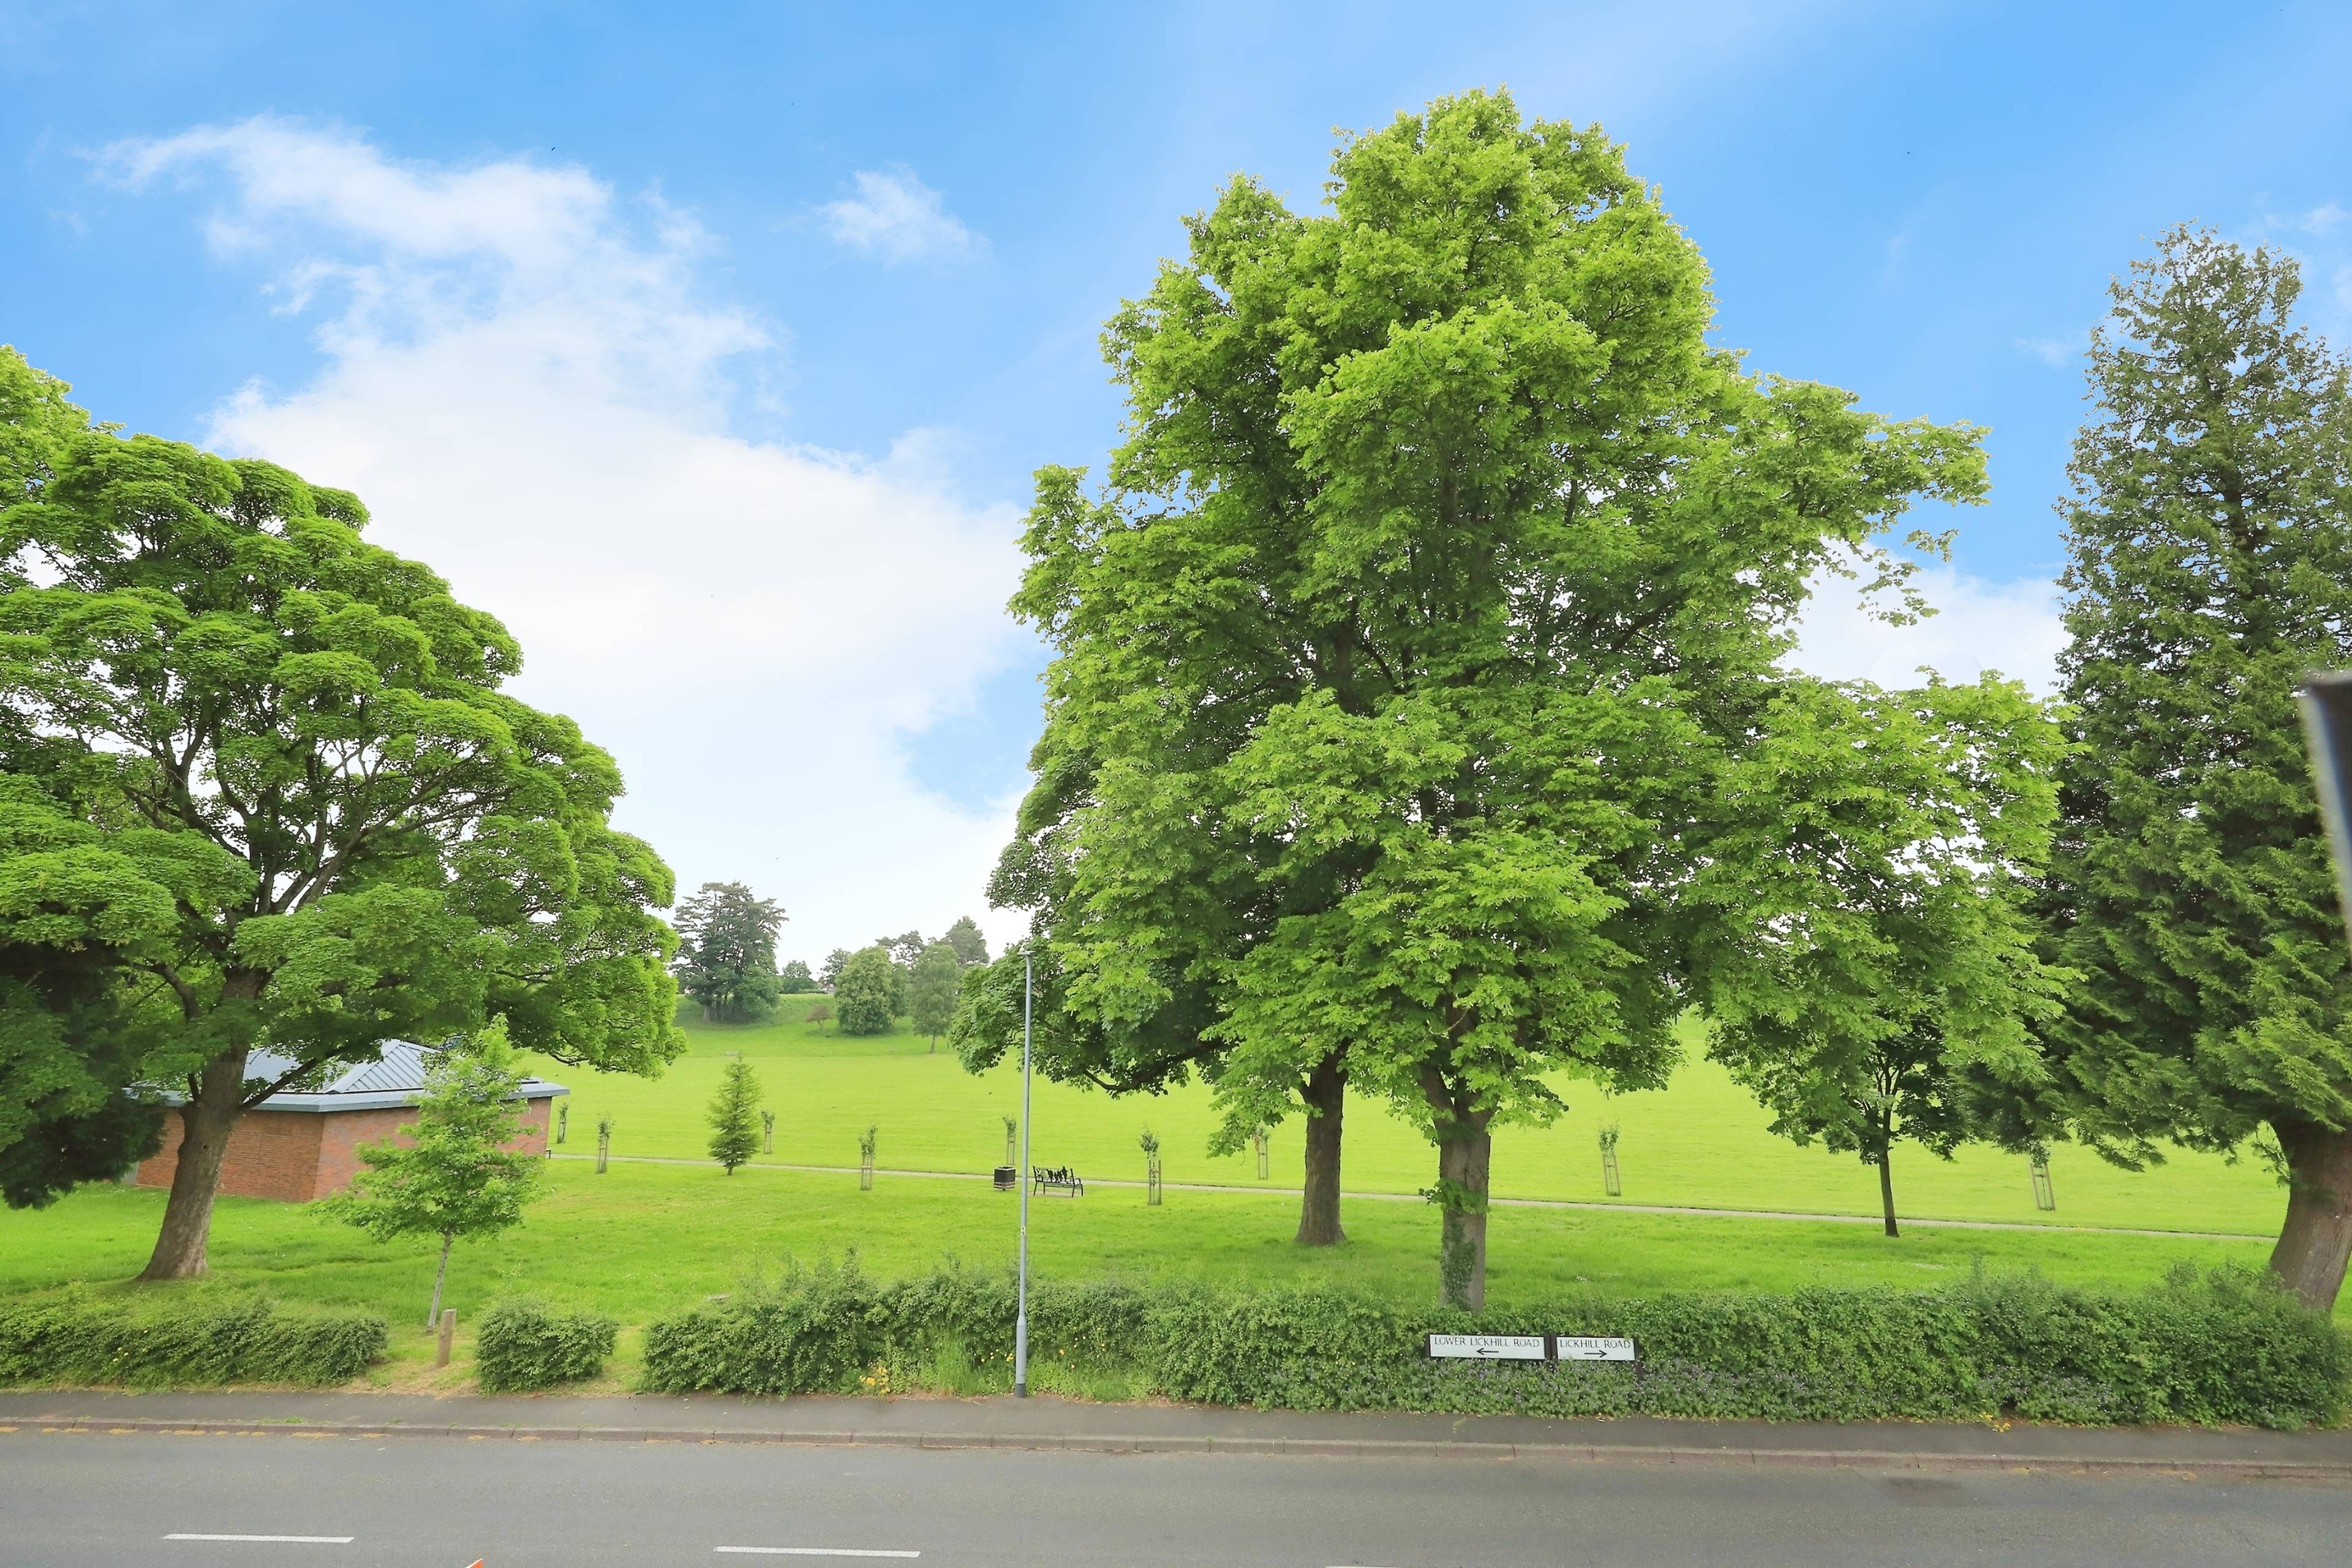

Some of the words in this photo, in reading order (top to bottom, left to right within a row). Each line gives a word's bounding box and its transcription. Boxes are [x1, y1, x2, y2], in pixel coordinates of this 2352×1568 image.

[1434, 1336, 1466, 1346] LOWER
[1471, 1337, 1510, 1347] LICKHILL
[1513, 1338, 1540, 1348] ROAD
[1560, 1339, 1600, 1348] LICKHILL
[1604, 1340, 1630, 1348] ROAD
